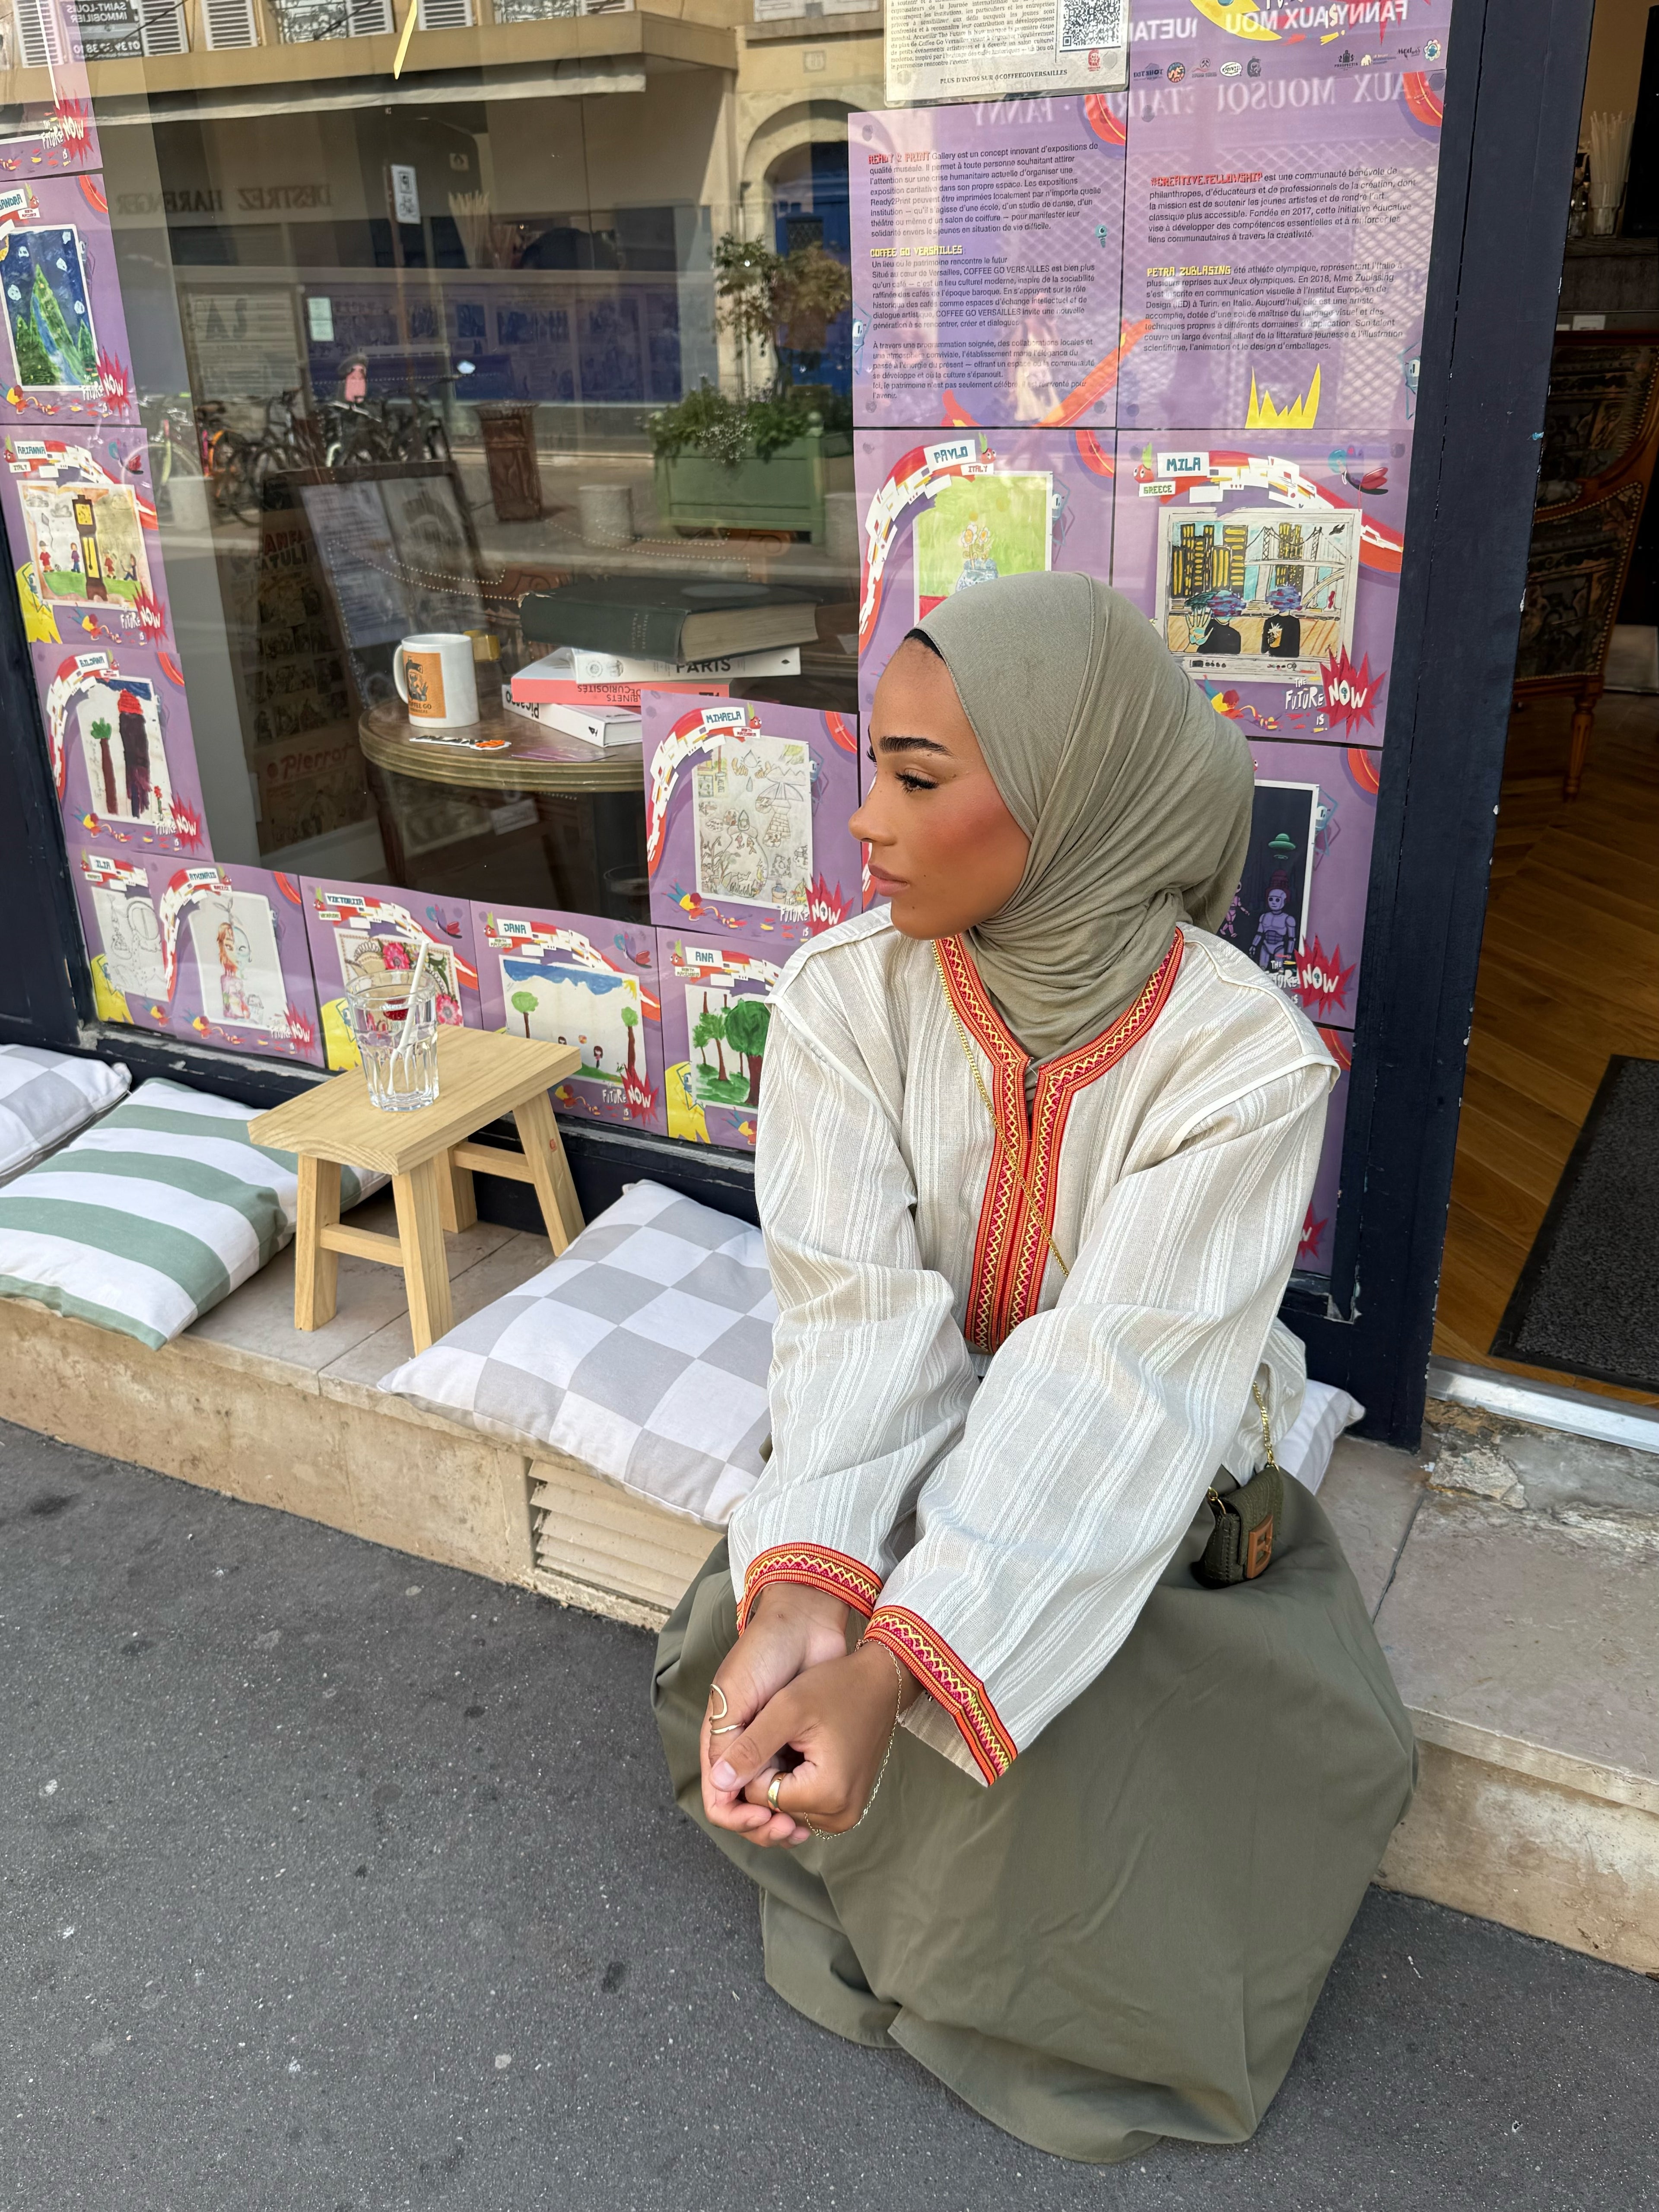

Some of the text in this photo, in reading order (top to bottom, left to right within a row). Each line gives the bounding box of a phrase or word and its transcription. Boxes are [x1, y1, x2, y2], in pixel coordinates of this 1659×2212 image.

[995, 70, 1067, 80] @COFFEEGOVERSAILLES
[63, 115, 84, 141] NOW
[932, 151, 956, 161] Gallery
[980, 148, 1008, 158] concept
[1010, 146, 1039, 154] innovant
[1041, 143, 1087, 154] d'expositions
[950, 171, 989, 180] humanitaire
[992, 169, 1017, 177] actuelle
[1020, 167, 1058, 177] d'organiser
[1295, 169, 1346, 179] communauté
[971, 183, 994, 191] propre
[995, 181, 1022, 190] espace.
[1038, 177, 1078, 187] expositions
[1149, 189, 1203, 200] philanthropes,
[1205, 187, 1255, 196] d'éducateurs
[1280, 183, 1337, 194] professionnels
[1158, 201, 1186, 209] mission
[1214, 198, 1245, 207] soutenir
[1261, 198, 1286, 206] jeunes
[1288, 195, 1317, 203] artistes
[1149, 213, 1184, 222] classique
[1186, 212, 1202, 221] plus
[1204, 210, 1247, 219] accessible.
[1249, 208, 1278, 216] Fondée
[1292, 207, 1313, 216] 2017,
[1316, 206, 1335, 214] cette
[1172, 222, 1214, 232] développer
[1233, 219, 1284, 230] compétences
[1287, 217, 1332, 226] essentielles
[1167, 233, 1230, 242] communautaires
[870, 245, 963, 258] COFFEE GO VERSAILLES
[1147, 264, 1231, 277] PETRA ZUBLASING
[103, 372, 124, 397] NOW
[934, 446, 969, 463] PAVLO
[1166, 457, 1201, 471] MILA
[1143, 484, 1173, 495] GREECE
[140, 605, 160, 629] NOW
[677, 658, 731, 673] PARIS
[577, 684, 630, 694] CURIOSITÉS
[1294, 678, 1307, 688] THE
[1285, 677, 1367, 710] FUTURE NOW
[706, 711, 742, 723] MIHAELA
[1316, 714, 1324, 725] IS
[176, 814, 196, 836] NOW
[812, 899, 841, 925] NOW
[503, 923, 527, 934] JANA
[803, 927, 809, 937] IS
[696, 951, 714, 963] ANA
[1271, 960, 1283, 969] THE
[1302, 963, 1338, 993] NOW
[291, 1020, 310, 1042] NOW
[602, 1084, 651, 1108] FUTURE NOW
